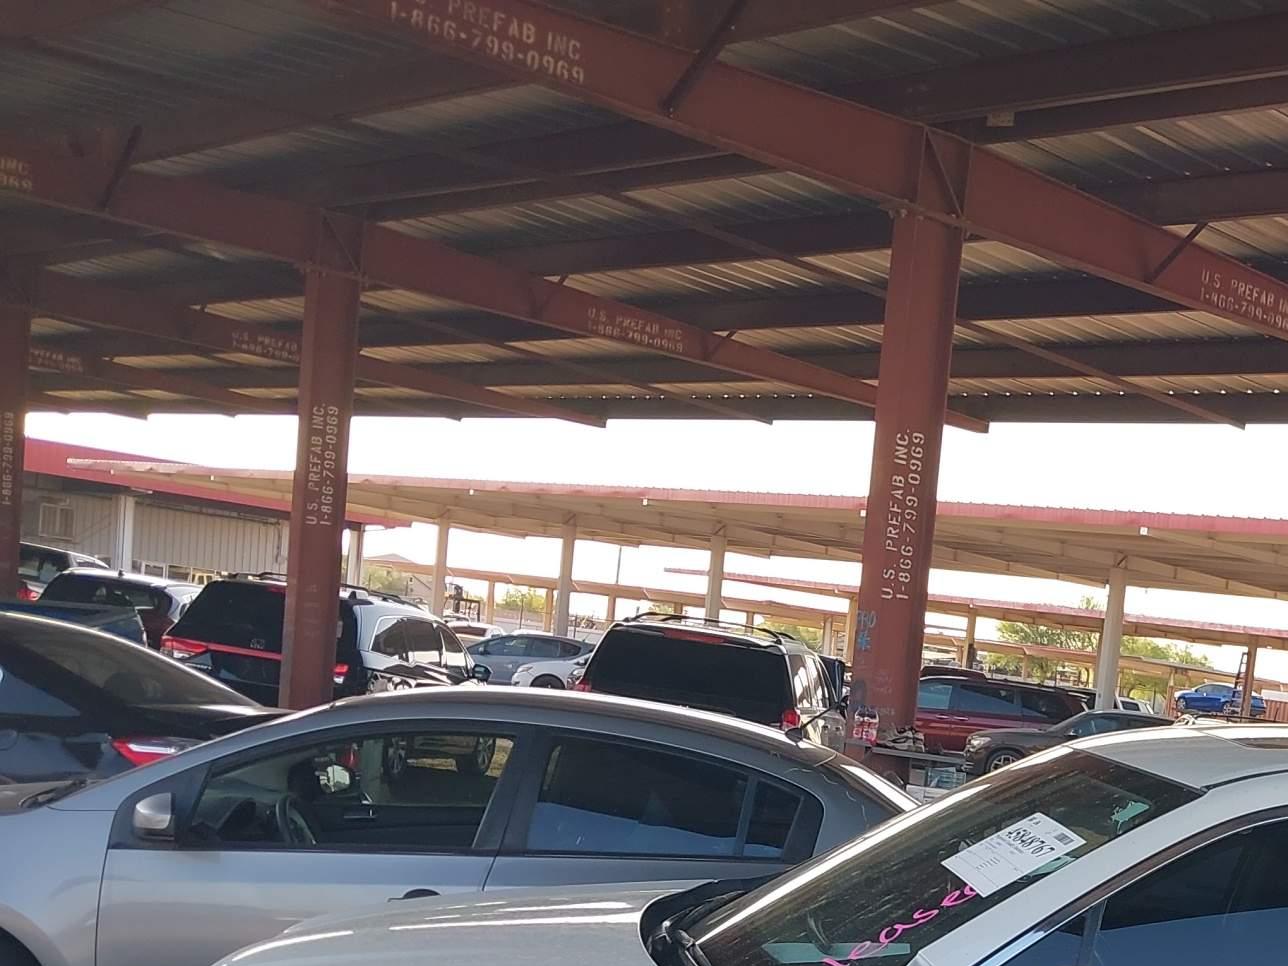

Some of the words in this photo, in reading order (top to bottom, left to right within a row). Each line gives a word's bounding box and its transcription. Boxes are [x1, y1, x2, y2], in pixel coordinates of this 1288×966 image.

[390, 1, 585, 84] 1-866-799-0969
[547, 31, 581, 60] INC
[1231, 279, 1275, 307] PREFAB
[308, 436, 323, 491] PREFAB
[320, 406, 339, 525] 1-866-799-0969
[894, 429, 910, 465] INC.
[886, 475, 905, 551] PREFAB
[896, 432, 925, 600] 1-866-799-0969
[881, 563, 897, 600] U.S.
[1005, 826, 1056, 858] 45848767
